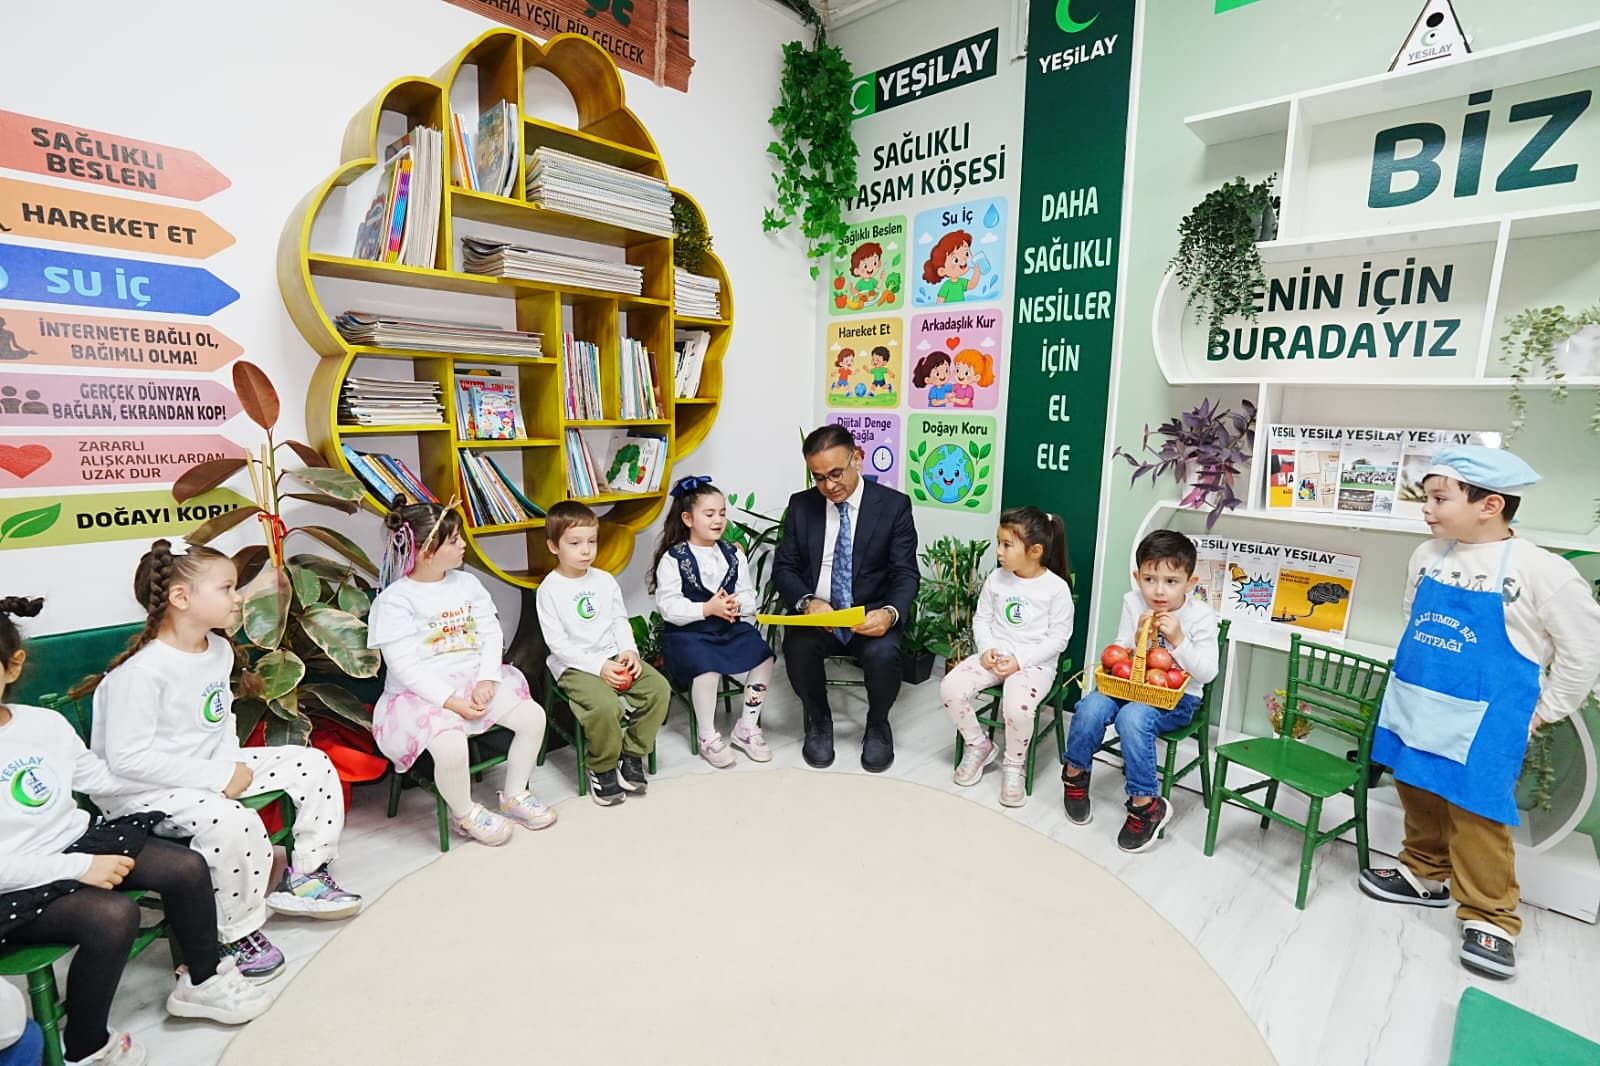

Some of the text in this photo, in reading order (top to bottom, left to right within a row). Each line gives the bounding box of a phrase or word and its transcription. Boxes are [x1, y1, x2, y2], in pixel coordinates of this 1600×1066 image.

[482, 0, 521, 17] AHA
[526, 2, 562, 33] YEŞİL
[592, 31, 644, 65] GELECEK
[1038, 34, 1119, 74] YEŞİLAY
[878, 38, 992, 102] YEŞİLAY
[31, 127, 164, 170] SAĞLIKLI
[873, 122, 970, 172] SAĞLIKLI
[1366, 89, 1593, 209] BİZ
[46, 153, 157, 190] BESLEN
[922, 144, 1006, 196] KÖŞESİ
[942, 206, 974, 227] Su İç
[1041, 186, 1099, 223] DAHA
[22, 203, 197, 245] HAREKET ET
[873, 222, 902, 238] Beslen
[1024, 236, 1112, 275] SAĞLIKLI
[43, 266, 102, 297] SU
[1252, 257, 1454, 316] NİN İÇİN
[1019, 287, 1111, 324] NESİLLER
[38, 317, 219, 349] İNTERNETE BAĞLI OL,
[838, 323, 891, 339] Hareket Et
[921, 315, 996, 334] Arkadaşlık Kur
[1206, 318, 1462, 362] BURADAYIZ
[71, 342, 197, 365] BAĞIMLI OLMA!
[1041, 338, 1080, 378] İÇİN
[80, 382, 201, 403] GERÇEK DÜNYAYA
[1048, 394, 1070, 422] EL
[52, 399, 226, 421] BAĞLAN, EKRANDAN KOP!
[865, 417, 892, 431] Denge
[922, 421, 988, 437] Doğayı Koru
[78, 441, 144, 452] ZARARLI
[81, 453, 225, 467] ALIŞKANLIKLARDAN
[1036, 443, 1070, 471] ELE
[82, 467, 161, 480] UZAK DUR
[76, 507, 170, 529] DOĞAYI
